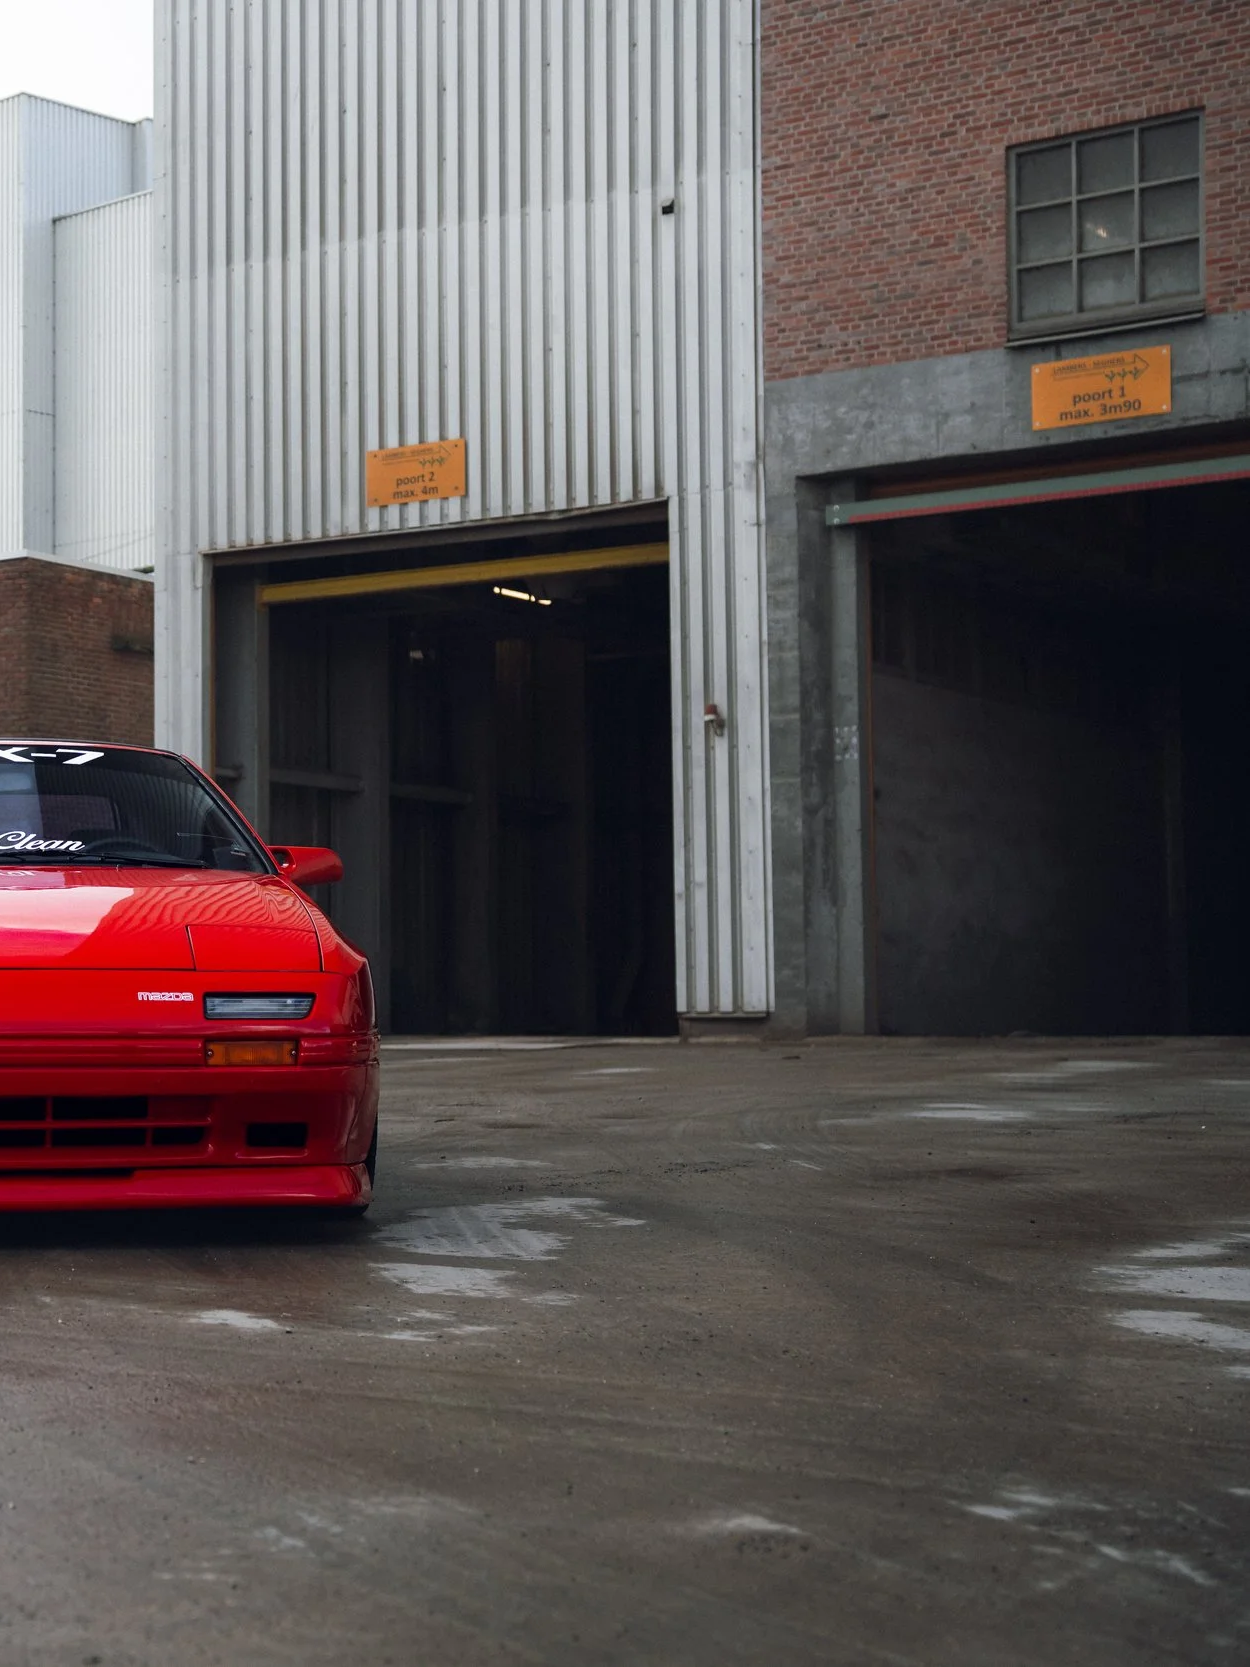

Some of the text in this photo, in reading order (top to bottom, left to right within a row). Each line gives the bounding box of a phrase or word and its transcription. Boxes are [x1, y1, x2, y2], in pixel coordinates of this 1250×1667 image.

[1073, 386, 1126, 406] poort 1
[1059, 399, 1142, 421] max. 3m90
[396, 471, 435, 488] poort 2
[393, 485, 439, 499] max. 4m
